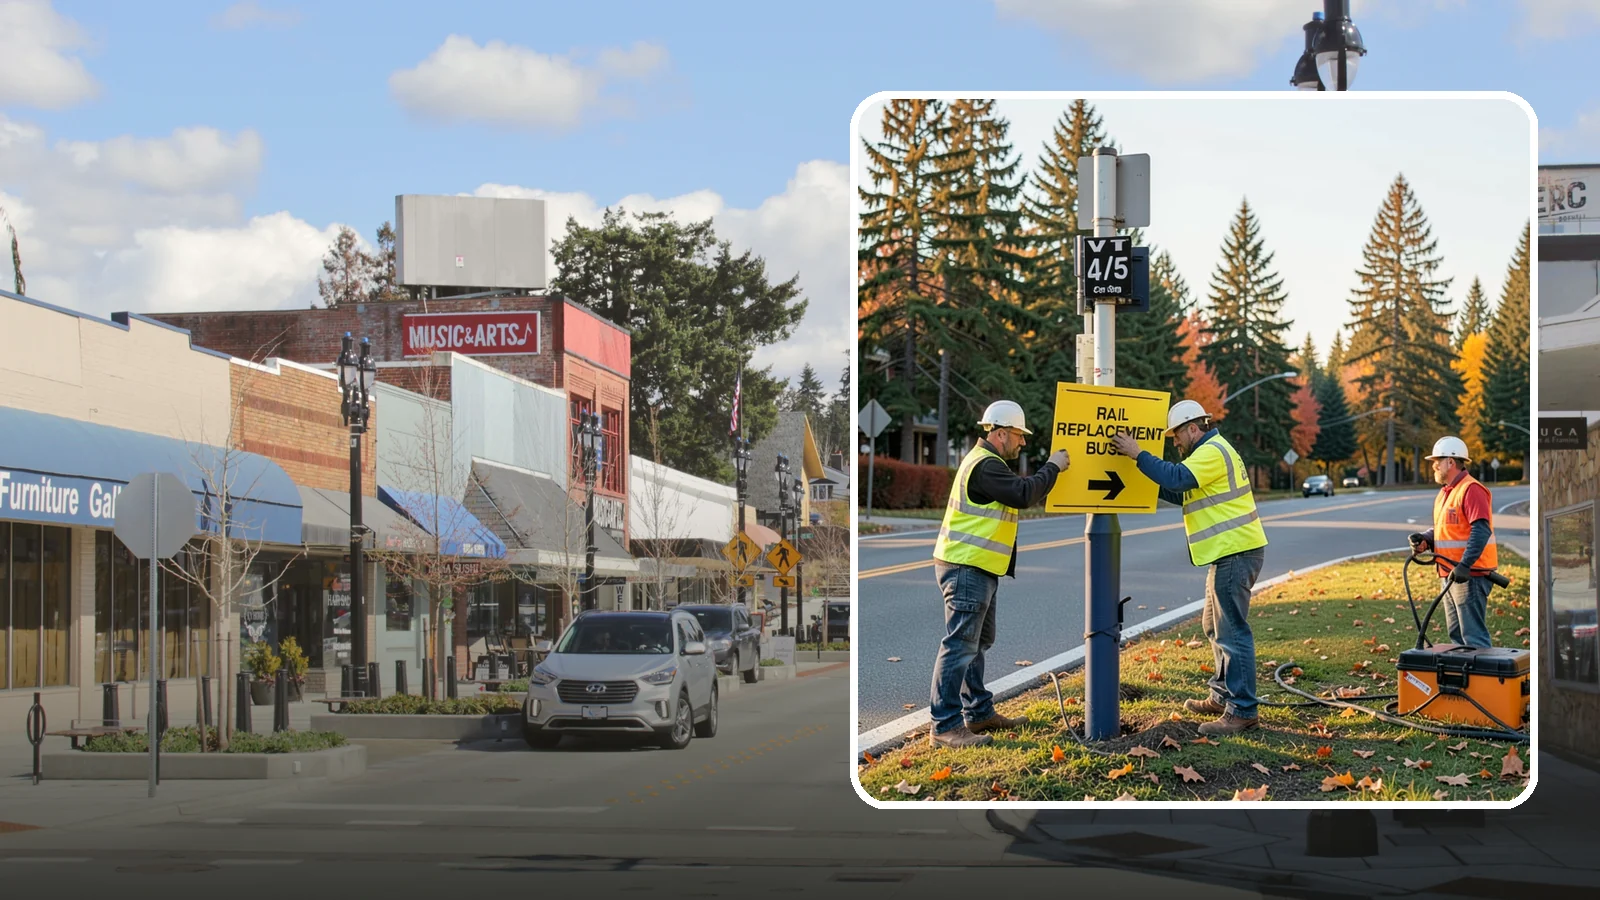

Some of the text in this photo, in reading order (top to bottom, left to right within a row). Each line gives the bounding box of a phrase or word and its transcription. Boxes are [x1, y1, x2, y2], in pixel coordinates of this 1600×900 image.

[1087, 255, 1128, 281] 4/5
[1096, 407, 1129, 421] RAIL
[1056, 422, 1164, 440] REPLACEMENT
[1086, 442, 1125, 455] BUS
[0, 471, 122, 519] Furniture Gal
[453, 563, 479, 574] SUSHI
